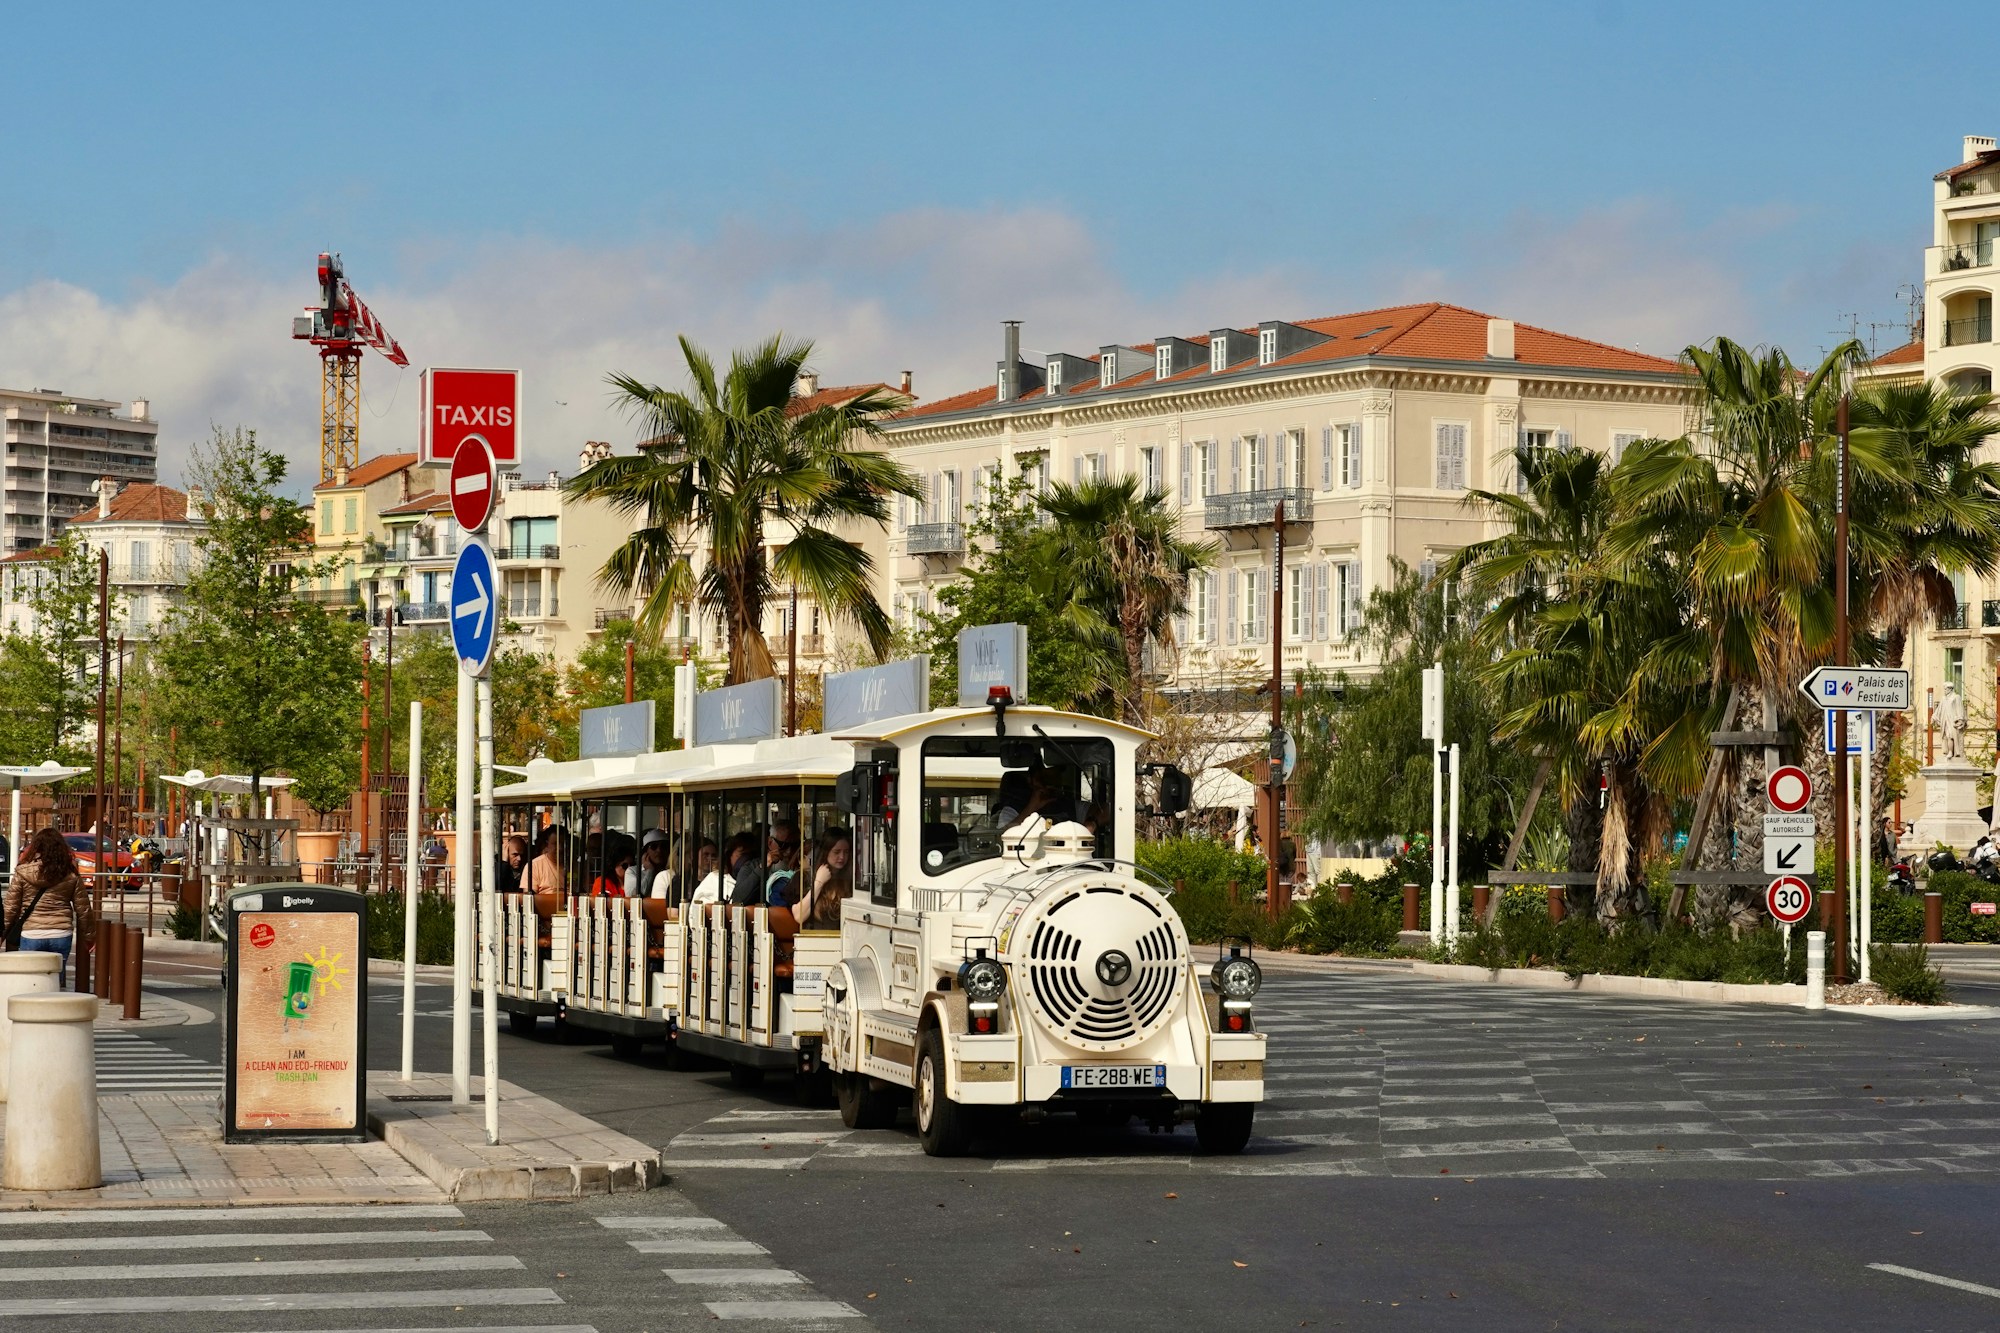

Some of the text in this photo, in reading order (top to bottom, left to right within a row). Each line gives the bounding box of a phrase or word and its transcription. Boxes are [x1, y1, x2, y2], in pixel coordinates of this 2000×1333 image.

[435, 404, 513, 427] TAXIS
[1857, 676, 1904, 688] Palais des
[1857, 691, 1900, 703] Festivals
[1782, 816, 1814, 824] VÉHICULES
[282, 895, 315, 908] Bigbelly
[1777, 890, 1802, 909] 30
[293, 1050, 306, 1059] AM
[245, 1061, 348, 1071] A CLEAN AND ECO-FRIENDLY
[275, 1073, 301, 1082] TRASH
[1074, 1067, 1153, 1086] FE-288-WE
[1155, 1076, 1165, 1085] 06
